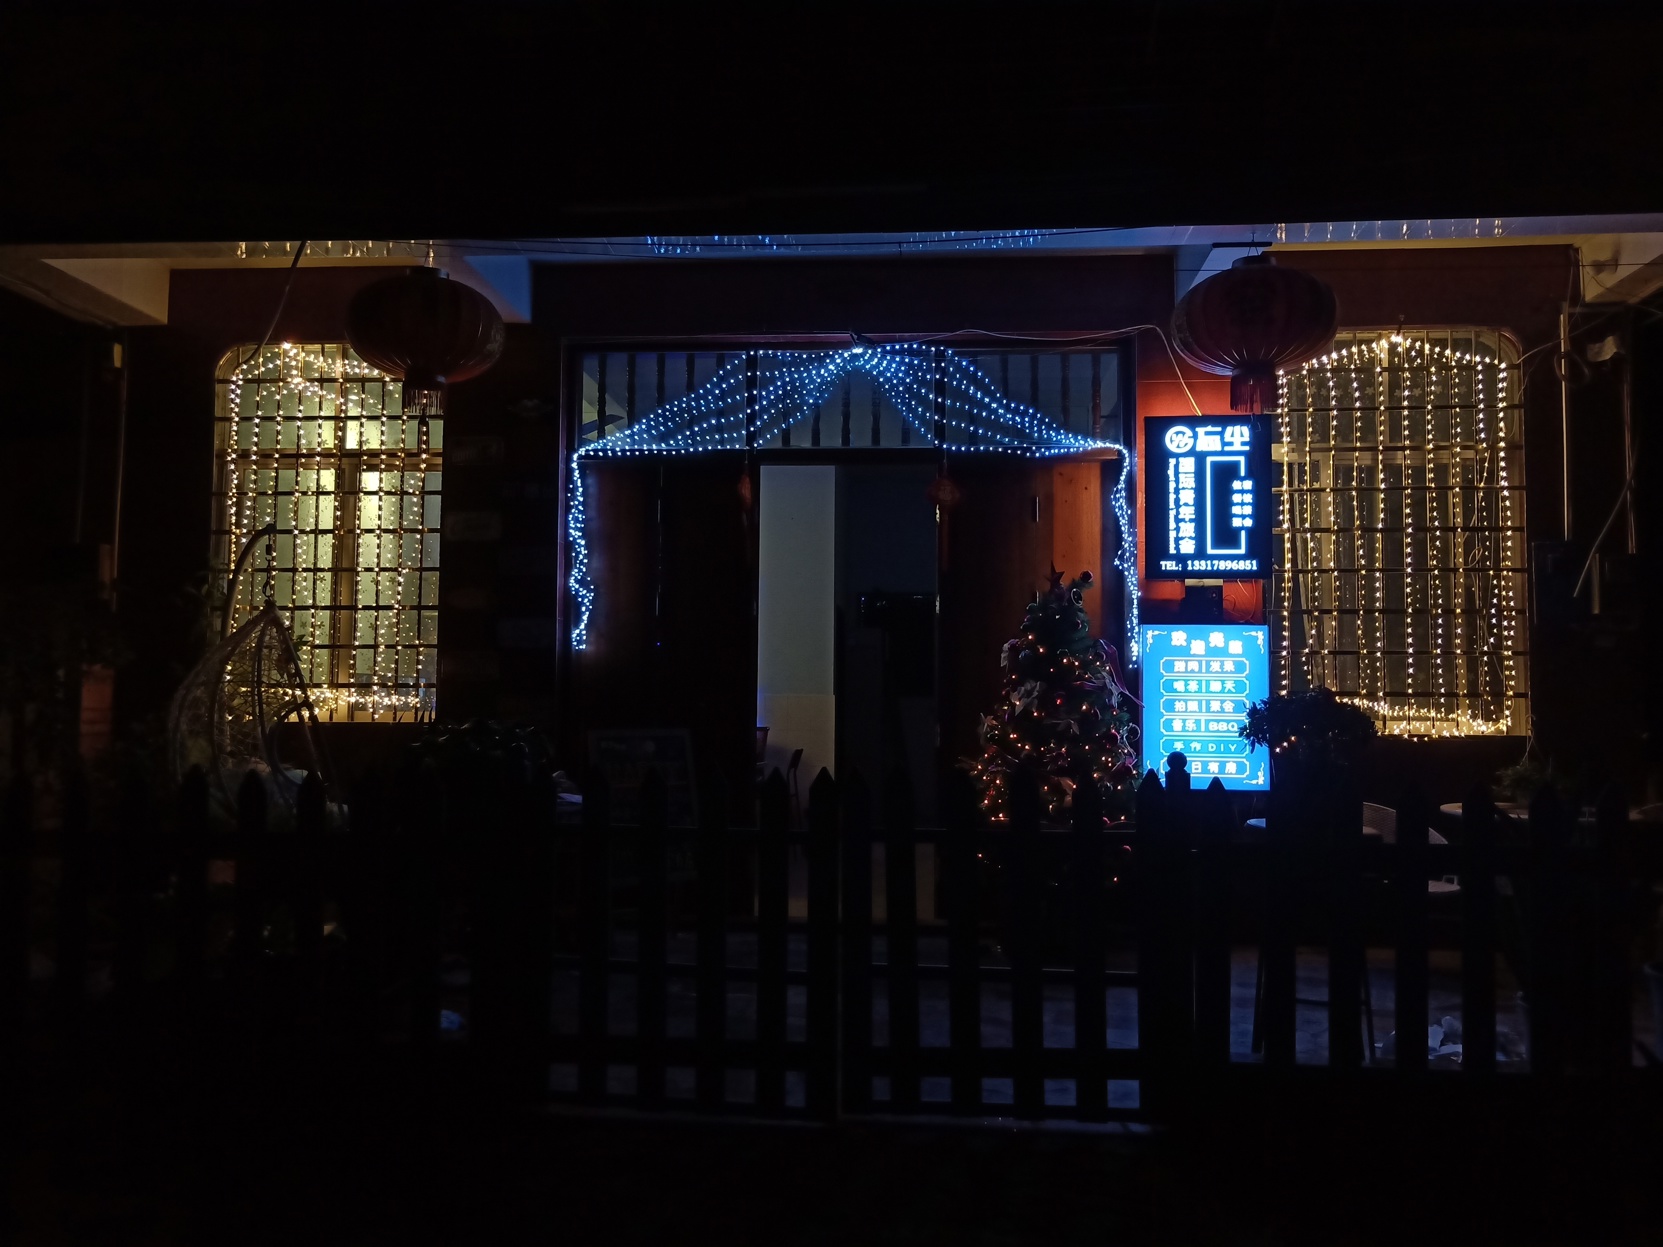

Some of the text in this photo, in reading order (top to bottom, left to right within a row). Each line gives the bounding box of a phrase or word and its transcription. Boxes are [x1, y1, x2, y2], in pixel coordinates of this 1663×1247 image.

[1195, 425, 1250, 451] 忘尘
[1179, 457, 1195, 553] 国际青年旅舍
[1187, 560, 1257, 570] 13317896851
[1171, 630, 1243, 655] 欢迎光临
[1173, 680, 1235, 692] 喝茶 聊天
[1174, 700, 1199, 712] 拍照
[1172, 718, 1238, 731] 音乐 BBQ
[1191, 761, 1237, 774] 日有房
